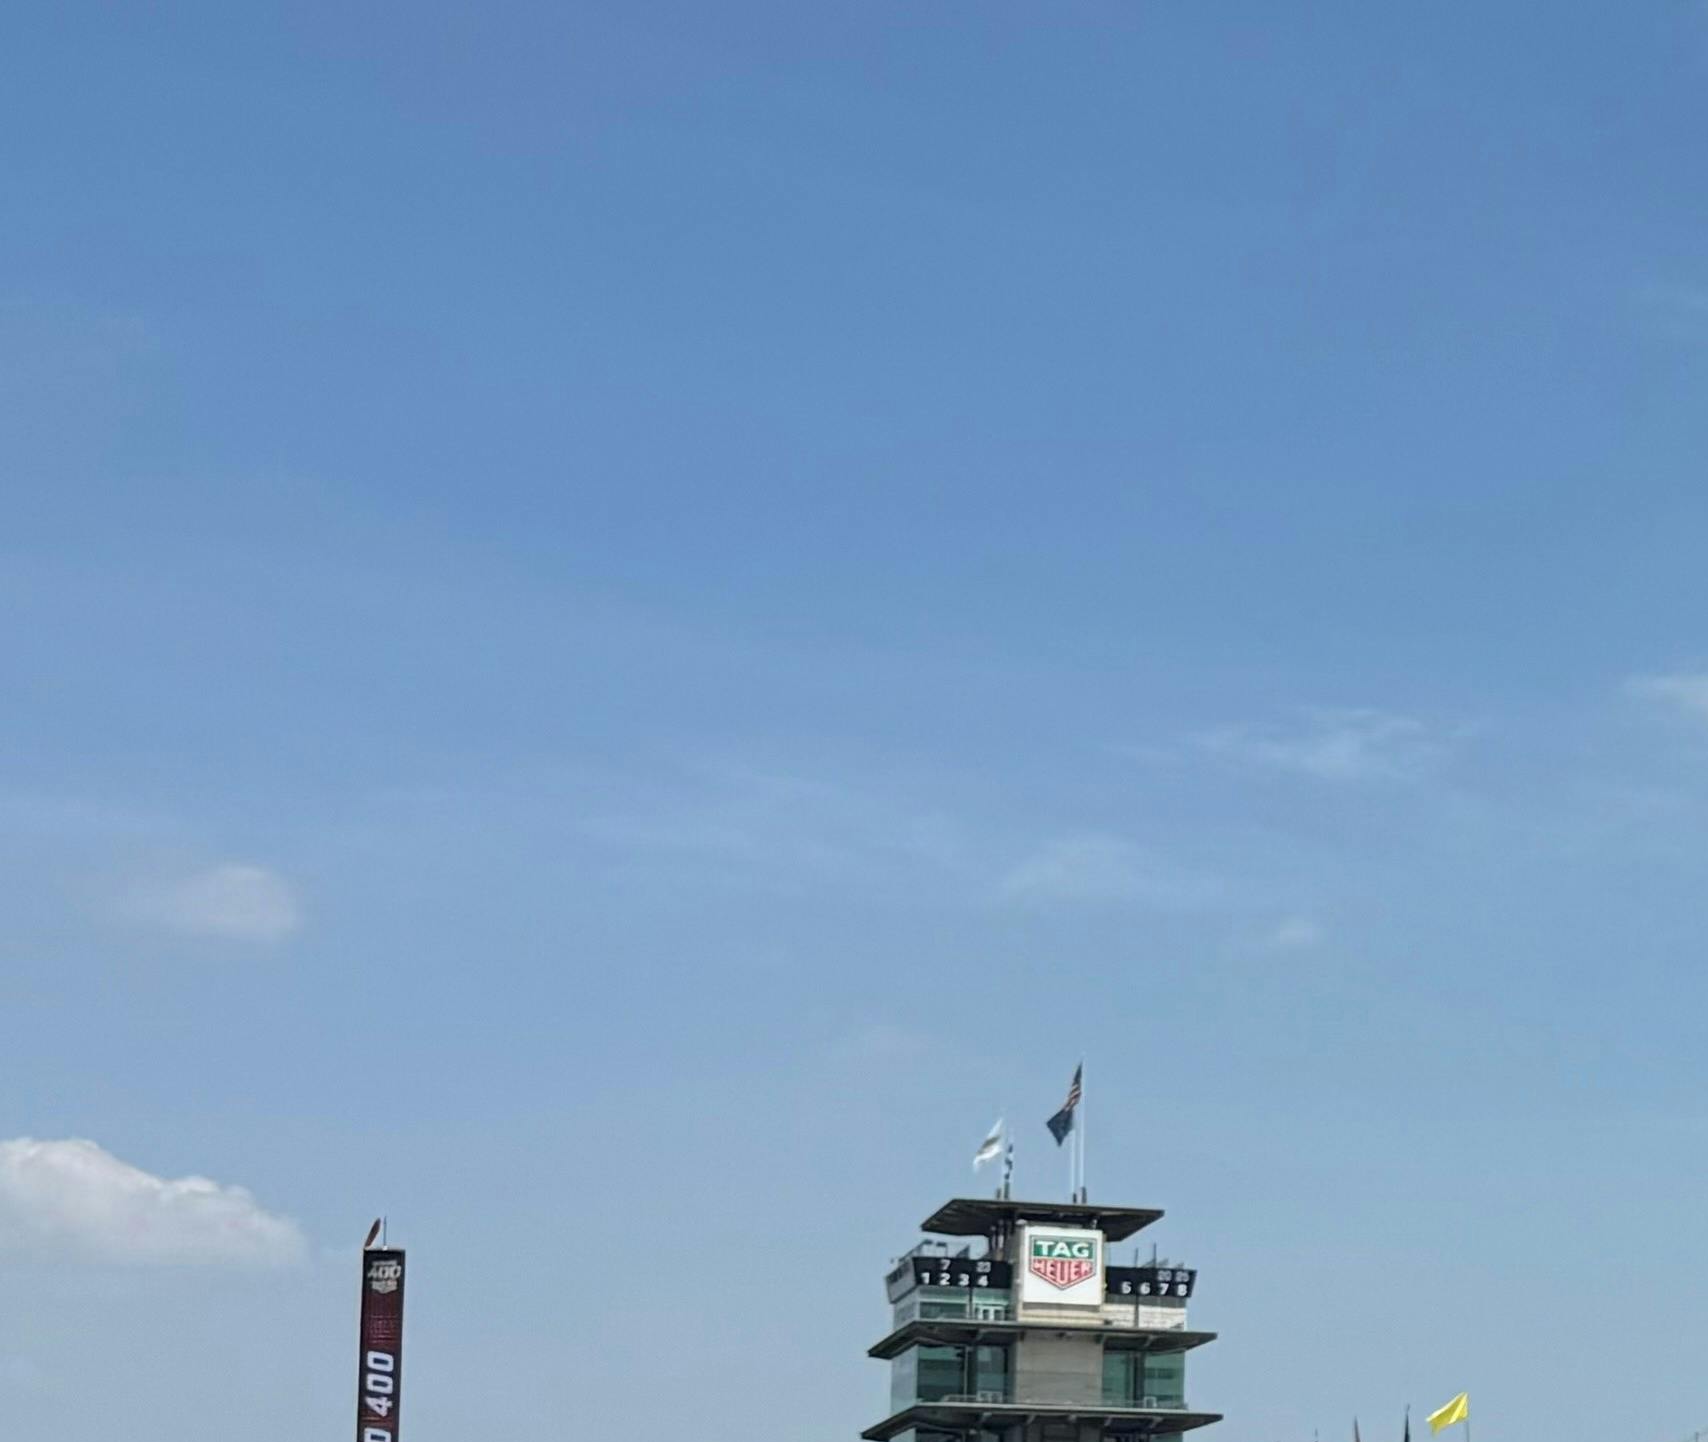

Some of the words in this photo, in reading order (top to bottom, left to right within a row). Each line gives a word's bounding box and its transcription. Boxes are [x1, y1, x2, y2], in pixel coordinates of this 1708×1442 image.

[1036, 1241, 1091, 1258] TAG
[367, 1266, 402, 1279] 400
[939, 1259, 951, 1271] 7
[1032, 1257, 1096, 1284] HEUER
[920, 1272, 930, 1285] 1
[939, 1272, 951, 1285] 2
[957, 1273, 970, 1286] 3
[977, 1274, 989, 1287] 4
[1121, 1281, 1132, 1294] 5
[1139, 1282, 1150, 1295] 6
[1159, 1282, 1169, 1295] 7
[364, 1350, 396, 1418] 400
